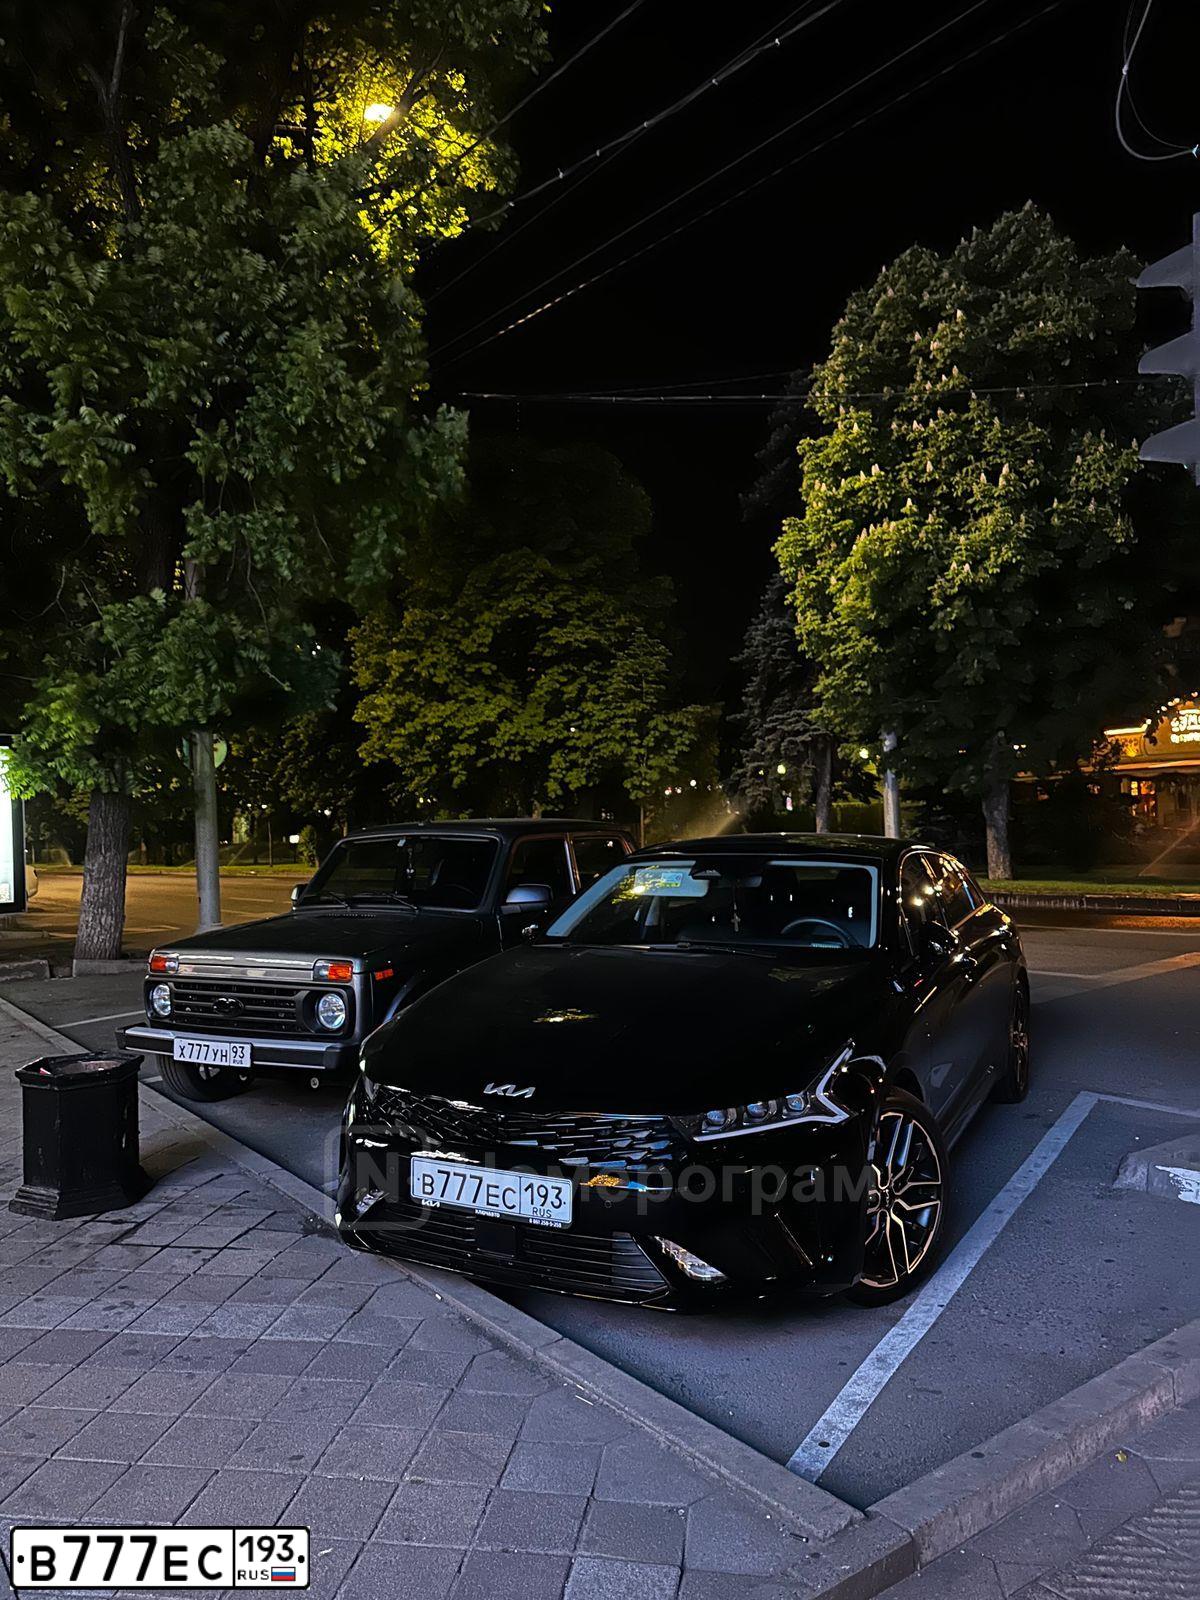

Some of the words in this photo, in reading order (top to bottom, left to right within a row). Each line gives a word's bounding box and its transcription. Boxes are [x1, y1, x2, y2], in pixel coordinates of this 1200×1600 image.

[179, 1043, 228, 1063] Х777УН
[231, 1045, 245, 1059] 93
[422, 1169, 517, 1210] В777ЕС
[524, 1182, 562, 1209] 193
[532, 1207, 552, 1218] RUS
